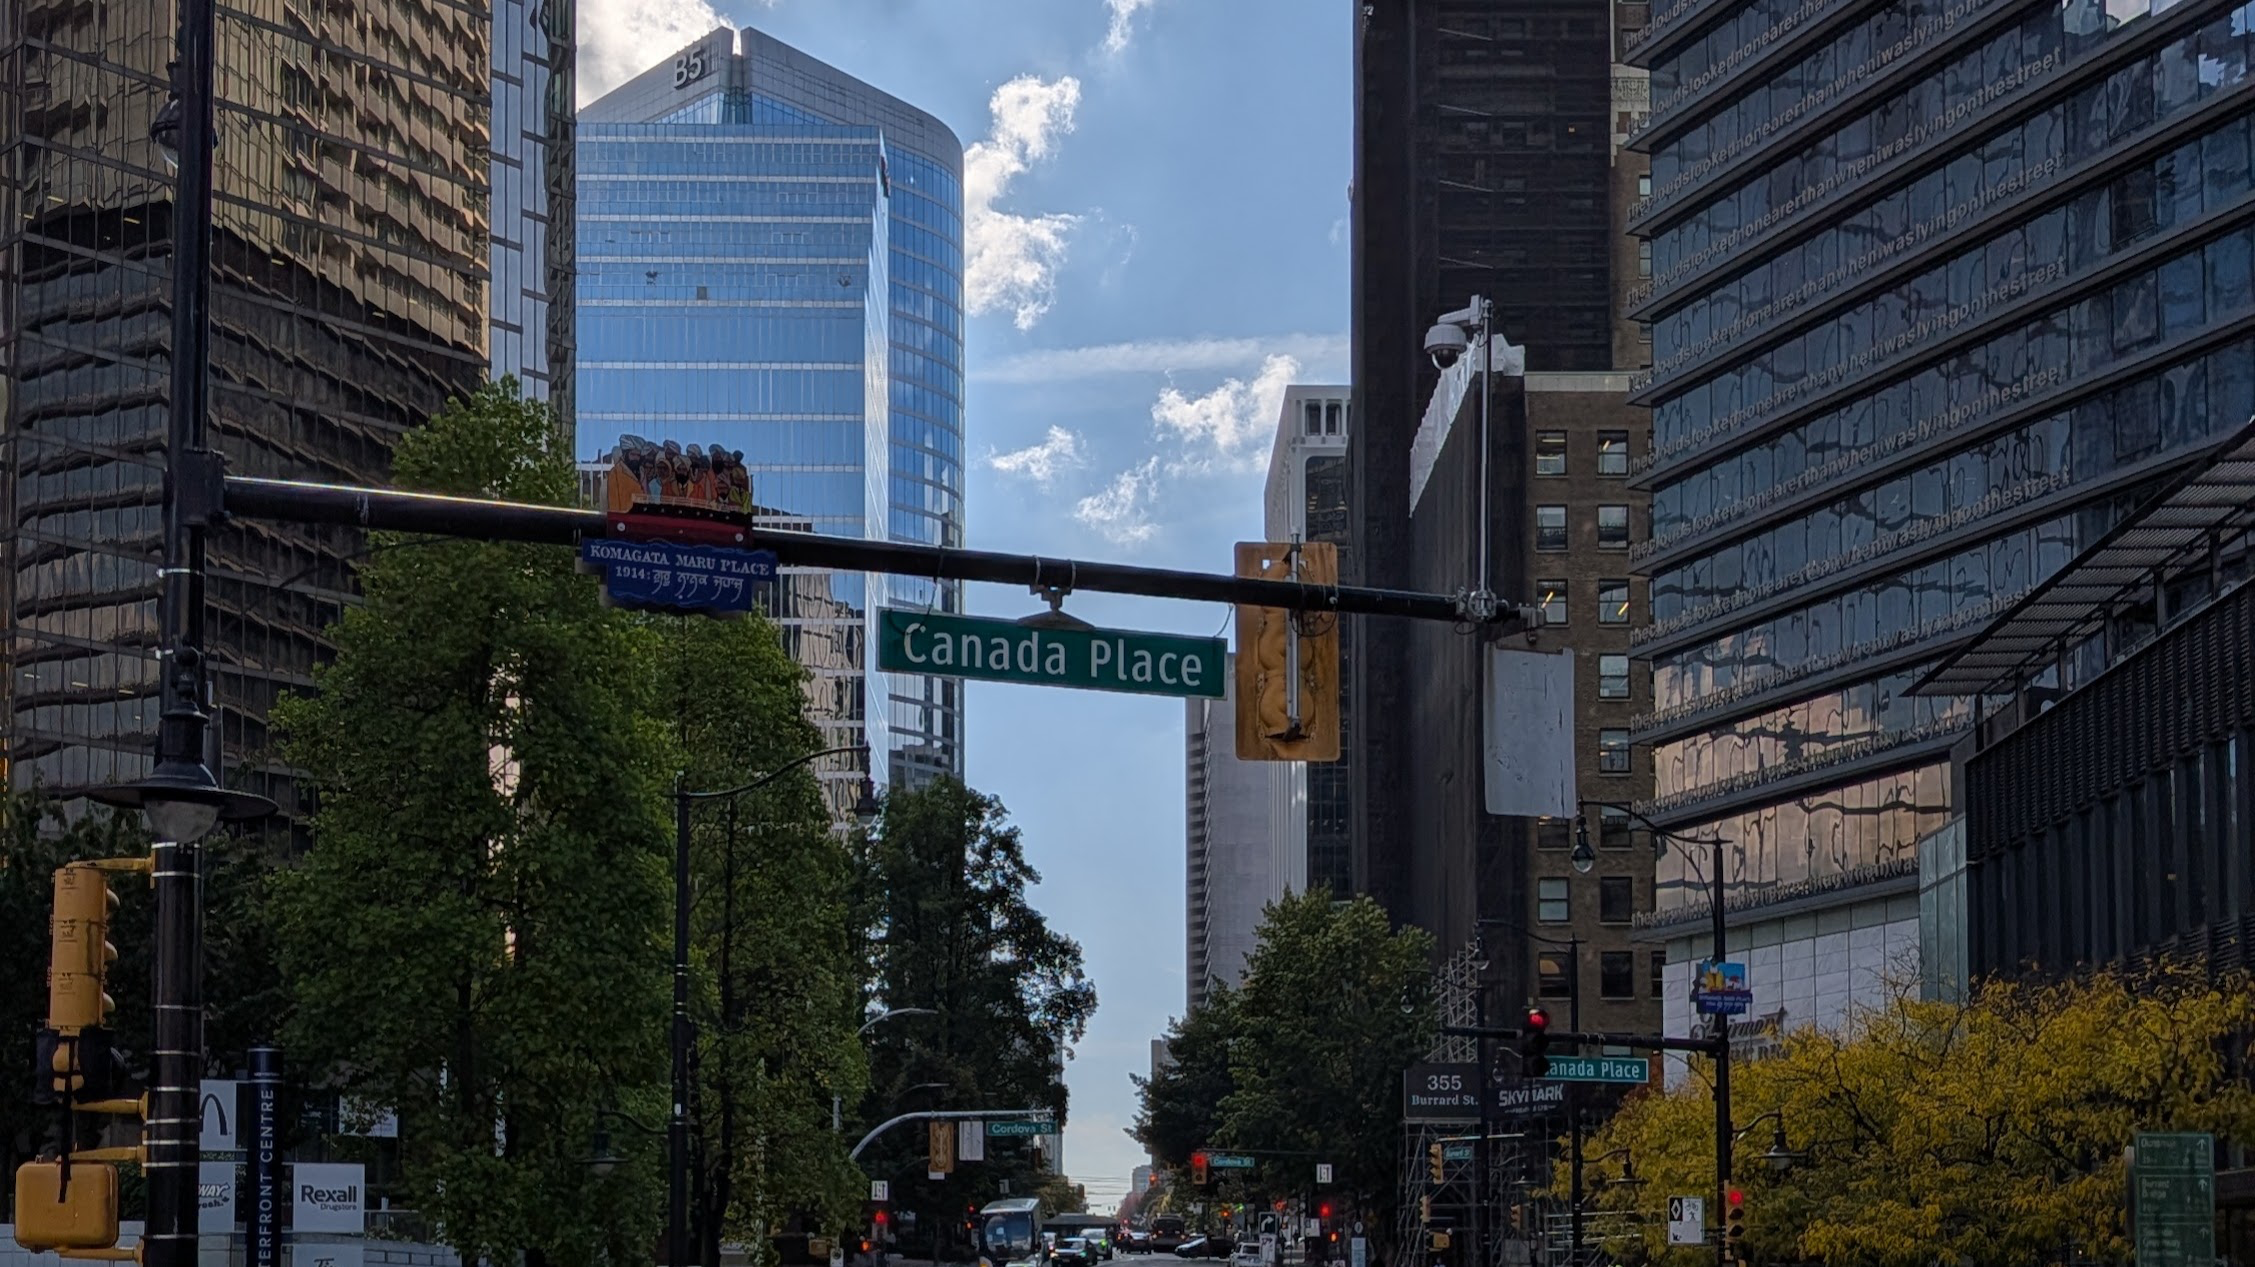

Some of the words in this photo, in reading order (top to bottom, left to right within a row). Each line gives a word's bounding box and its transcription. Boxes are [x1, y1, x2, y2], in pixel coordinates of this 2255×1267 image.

[671, 44, 704, 74] B5
[589, 544, 670, 566] KOMAGATA
[675, 554, 716, 570] MARU
[720, 559, 770, 576] PLACE
[904, 622, 1067, 676] Canada
[1089, 638, 1203, 687] Place
[1545, 1060, 1595, 1077] anada
[1601, 1060, 1640, 1078] Place
[1427, 1075, 1463, 1091] 355
[1411, 1094, 1458, 1106] Burrard
[1462, 1094, 1479, 1106] St.
[260, 1089, 275, 1163] CENTRE
[991, 1123, 1037, 1134] Cordova
[1040, 1123, 1052, 1134] St
[301, 1184, 357, 1205] Rexall
[320, 1203, 357, 1212] Drugstore
